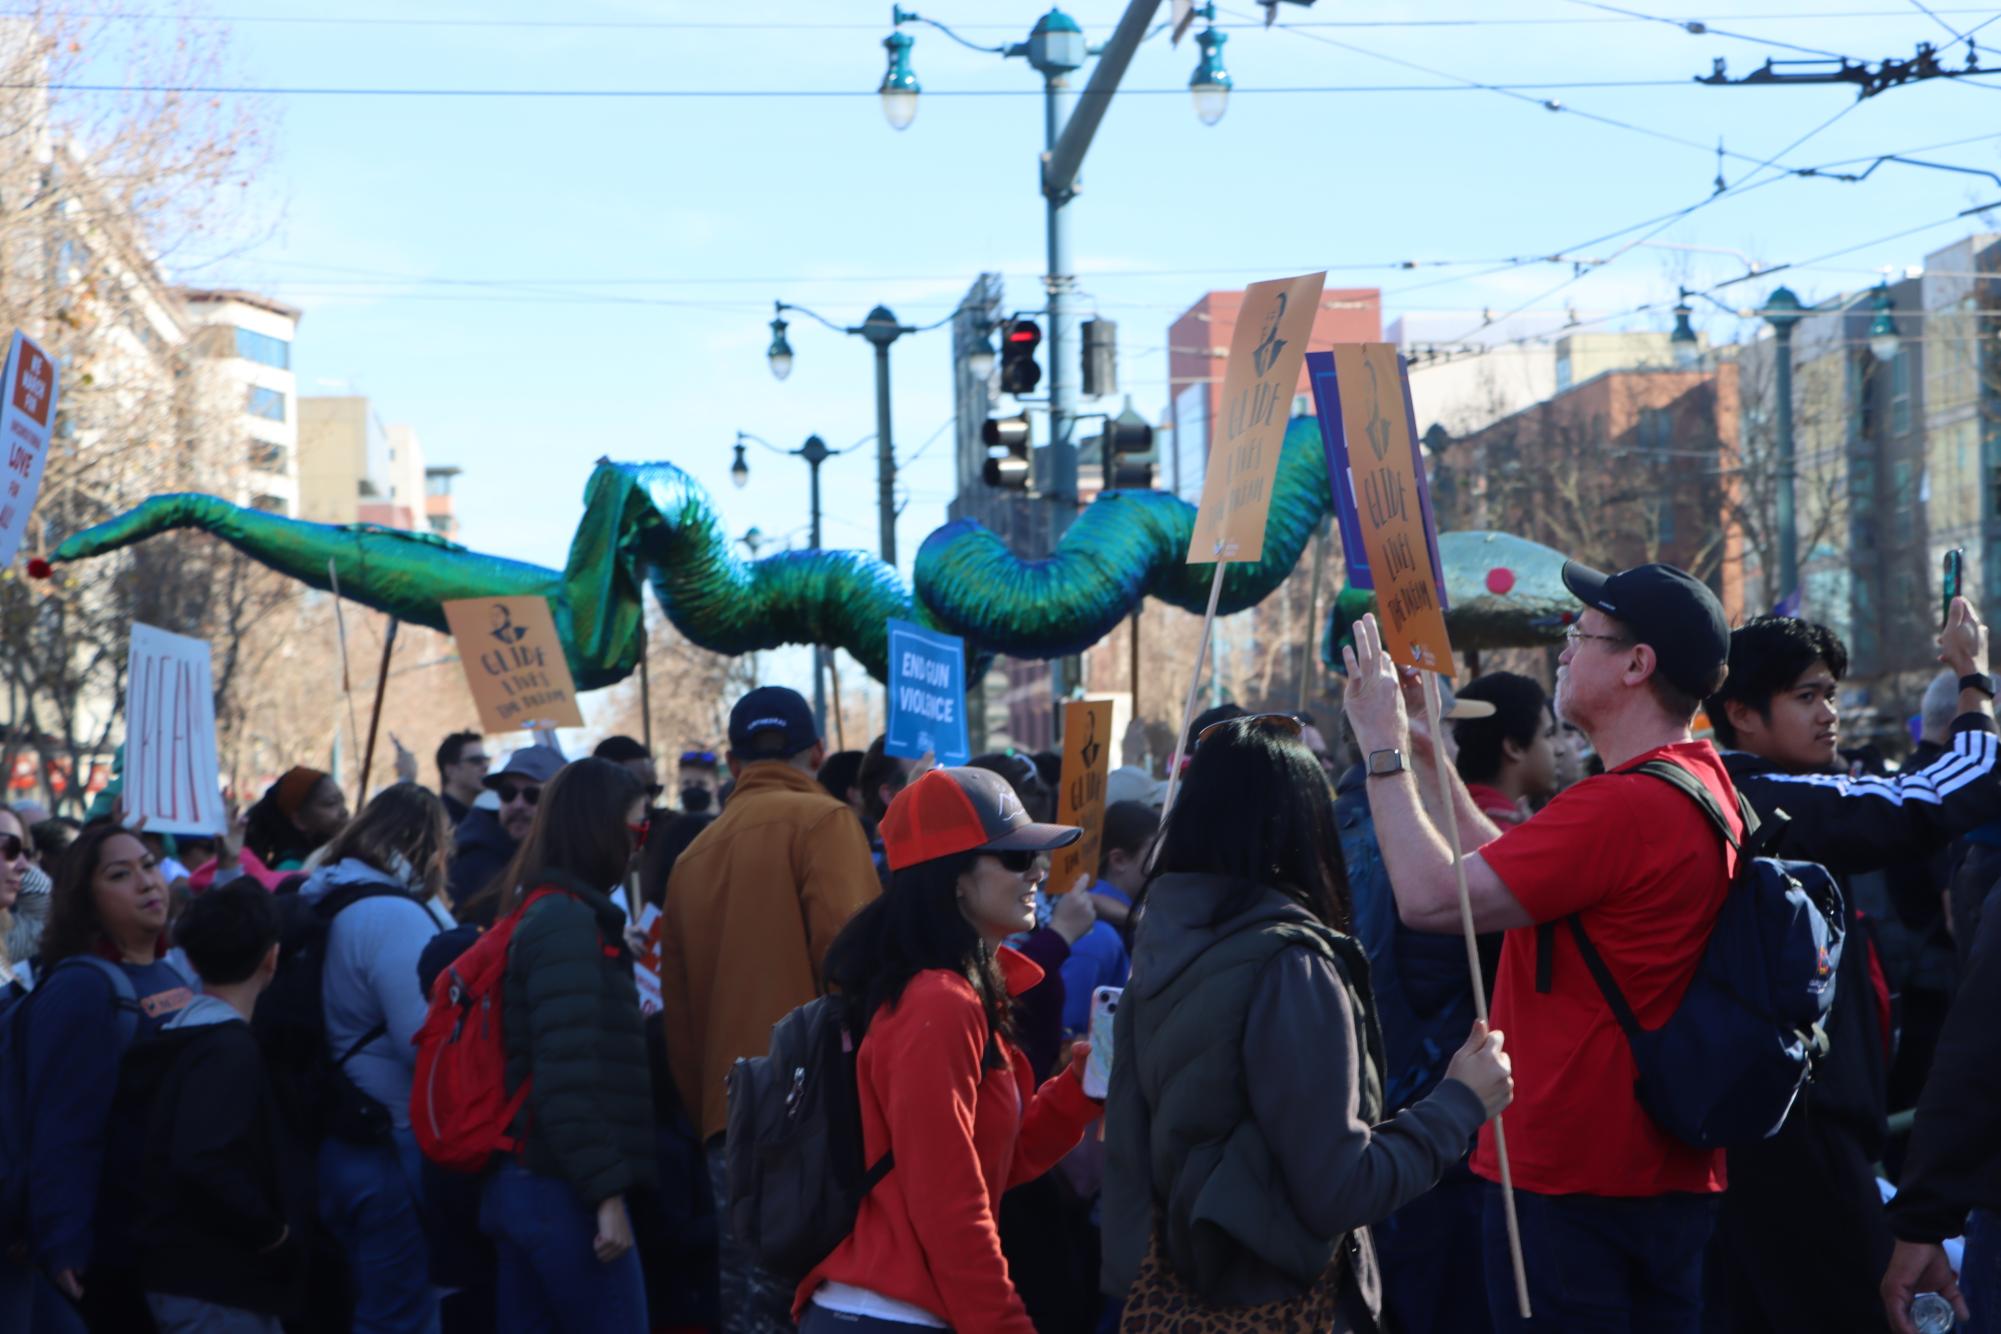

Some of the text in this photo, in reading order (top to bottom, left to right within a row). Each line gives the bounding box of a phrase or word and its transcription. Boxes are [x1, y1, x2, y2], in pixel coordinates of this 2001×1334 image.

[1228, 381, 1280, 441] GLIDE
[9, 442, 33, 478] LOVE
[1364, 466, 1409, 529] GLIDE
[1382, 533, 1416, 582] LIVES
[902, 651, 950, 689] END GUN
[900, 685, 954, 723] VIOLENCE
